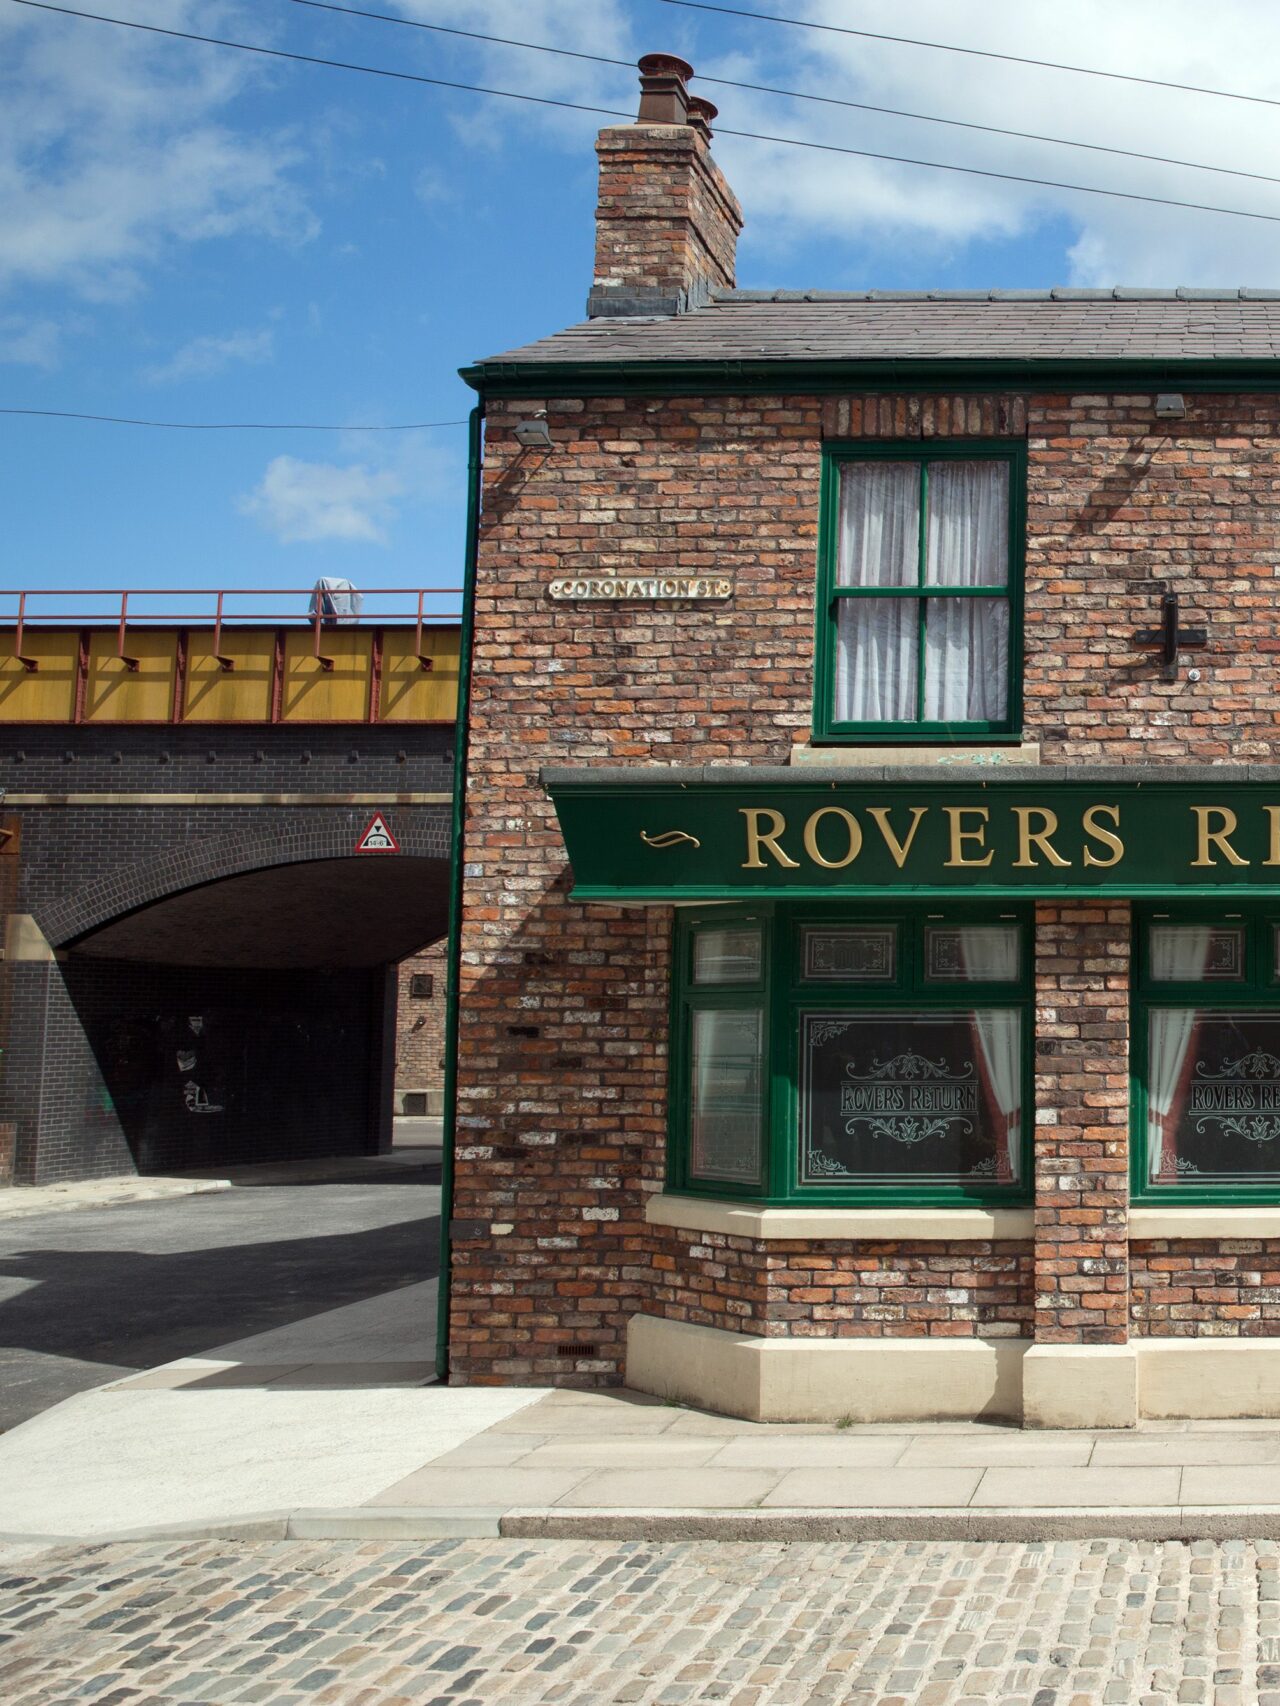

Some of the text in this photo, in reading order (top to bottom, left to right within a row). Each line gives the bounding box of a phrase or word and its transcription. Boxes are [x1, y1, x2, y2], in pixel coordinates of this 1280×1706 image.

[560, 580, 691, 598] CORONATION
[738, 803, 1125, 869] ROVERS
[841, 1085, 978, 1111] ROVERS RETURN
[1191, 1084, 1255, 1110] ROVERS
